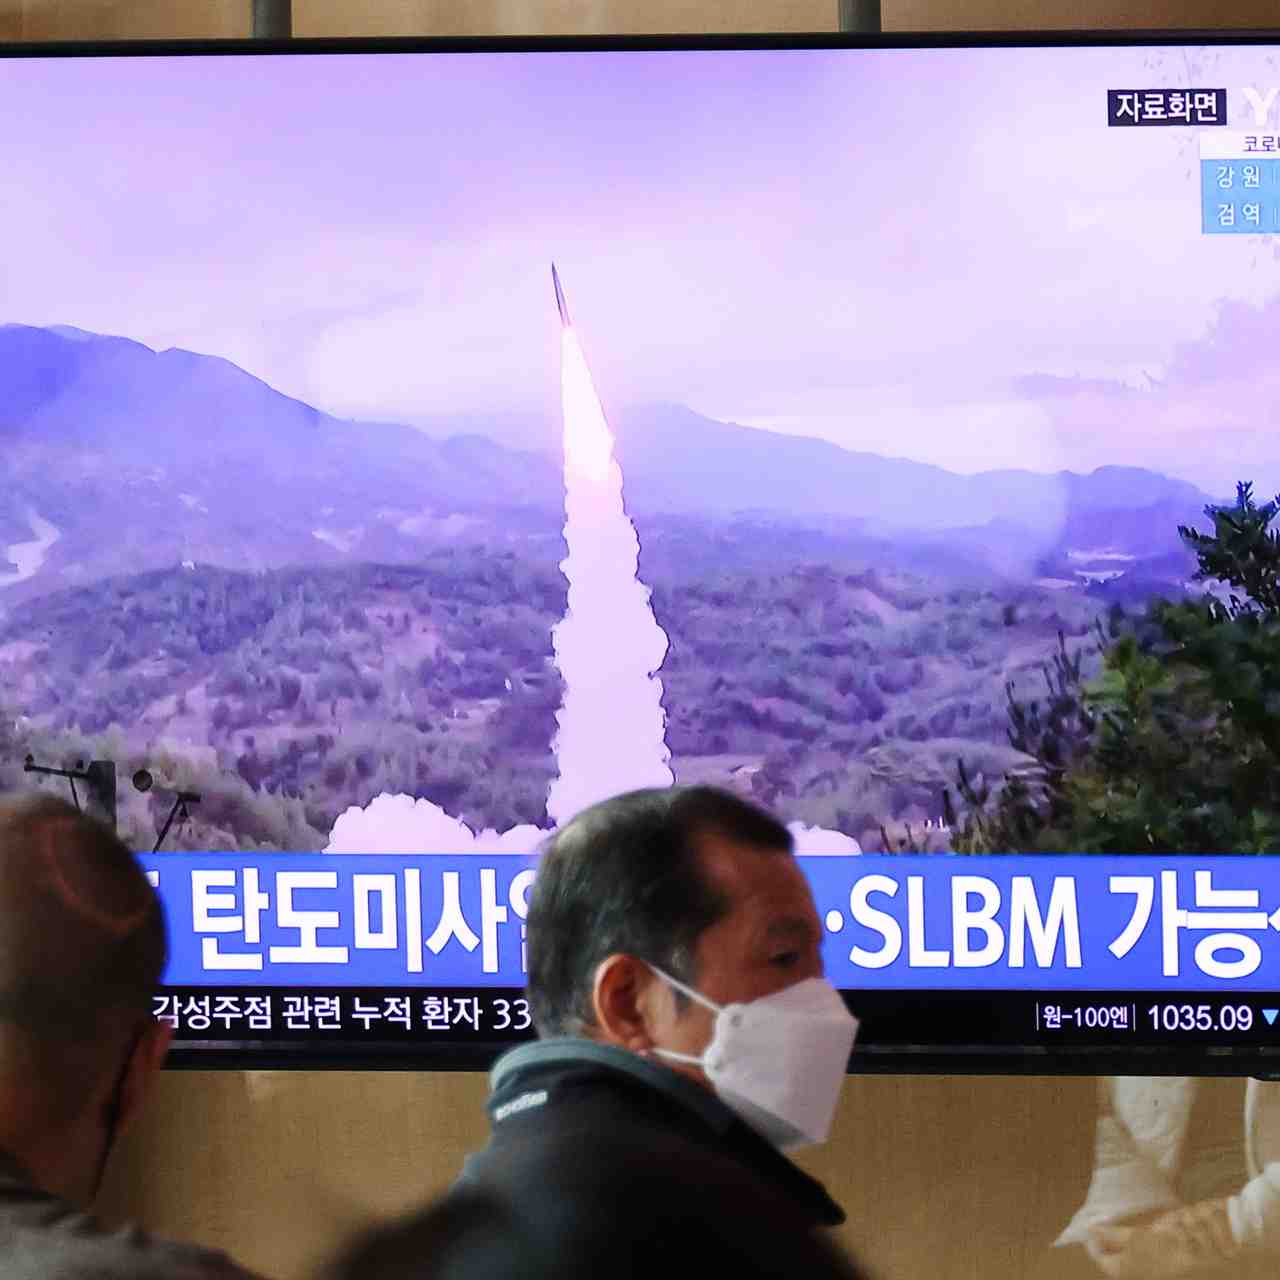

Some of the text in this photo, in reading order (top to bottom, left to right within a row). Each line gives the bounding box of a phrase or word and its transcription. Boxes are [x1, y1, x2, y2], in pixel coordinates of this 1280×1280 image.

[1116, 92, 1218, 123] 자료화면
[152, 995, 272, 1030] 감성주점
[282, 996, 342, 1030] 관련
[351, 996, 412, 1031] 누적
[422, 996, 483, 1031] 환자
[1148, 1005, 1253, 1031] 1035.09
